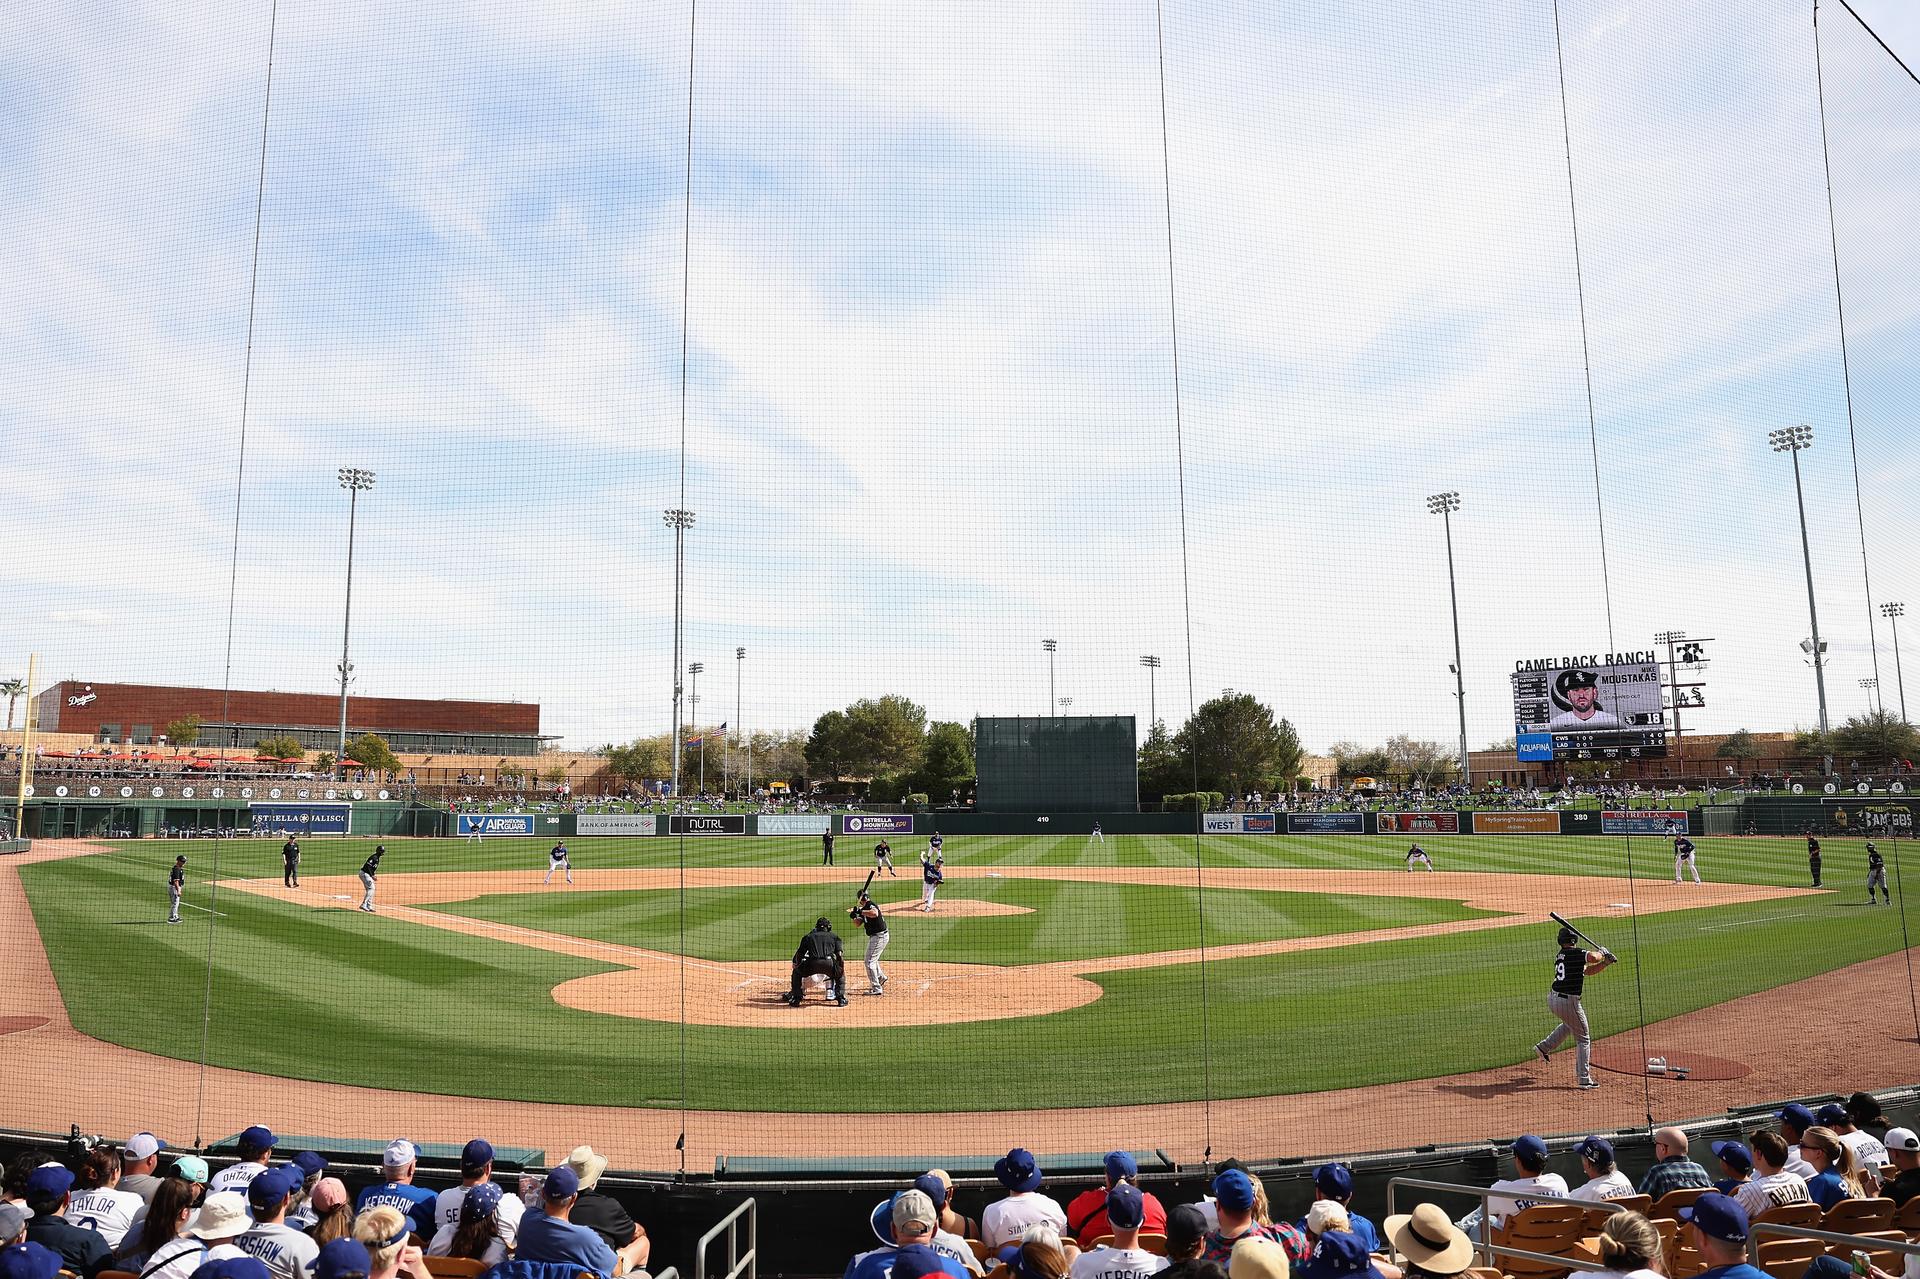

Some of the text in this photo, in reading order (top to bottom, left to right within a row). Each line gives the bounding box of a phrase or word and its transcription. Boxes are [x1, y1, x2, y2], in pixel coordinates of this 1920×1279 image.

[1516, 650, 1656, 672] CAMELBACK RANCH
[1602, 672, 1657, 684] MOUSTAKAS
[1647, 713, 1660, 724] 18
[1520, 743, 1550, 752] AQUAFINA
[486, 819, 504, 830] AIR
[1207, 822, 1234, 830] WEST
[1248, 818, 1272, 828] plays
[1423, 820, 1436, 828] PEAKS
[1555, 962, 1566, 981] 9
[223, 1172, 254, 1182] OHTAN
[71, 1196, 115, 1214] TAYLOR
[365, 1195, 415, 1214] KERSHAW
[446, 1208, 460, 1223] SE
[233, 1236, 283, 1262] ERSHAW
